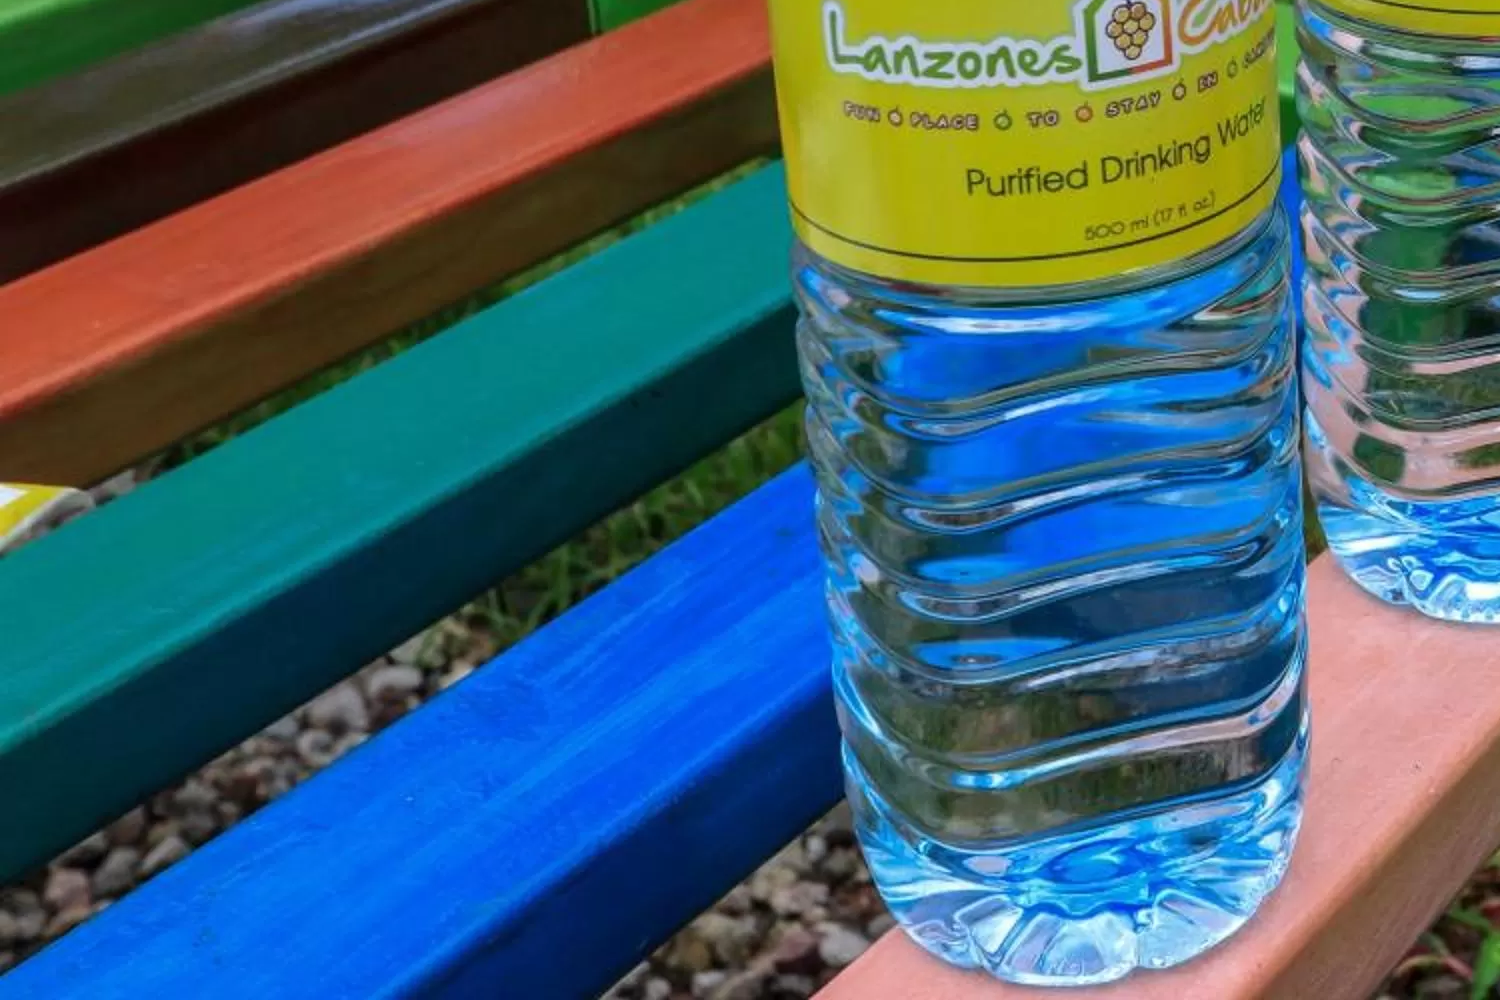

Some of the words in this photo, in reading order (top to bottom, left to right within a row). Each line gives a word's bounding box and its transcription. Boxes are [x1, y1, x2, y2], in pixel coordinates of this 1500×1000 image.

[828, 10, 1082, 79] Lanzones
[843, 100, 880, 122] FUN
[910, 111, 980, 131] PLACE
[1026, 108, 1060, 128] TO
[1105, 89, 1161, 119] STAY
[965, 159, 1089, 197] Purified
[1101, 135, 1212, 184] Drinking
[1216, 96, 1267, 147] Water
[1084, 220, 1126, 241] 500
[1130, 215, 1149, 233] ml
[1152, 205, 1173, 228] (17
